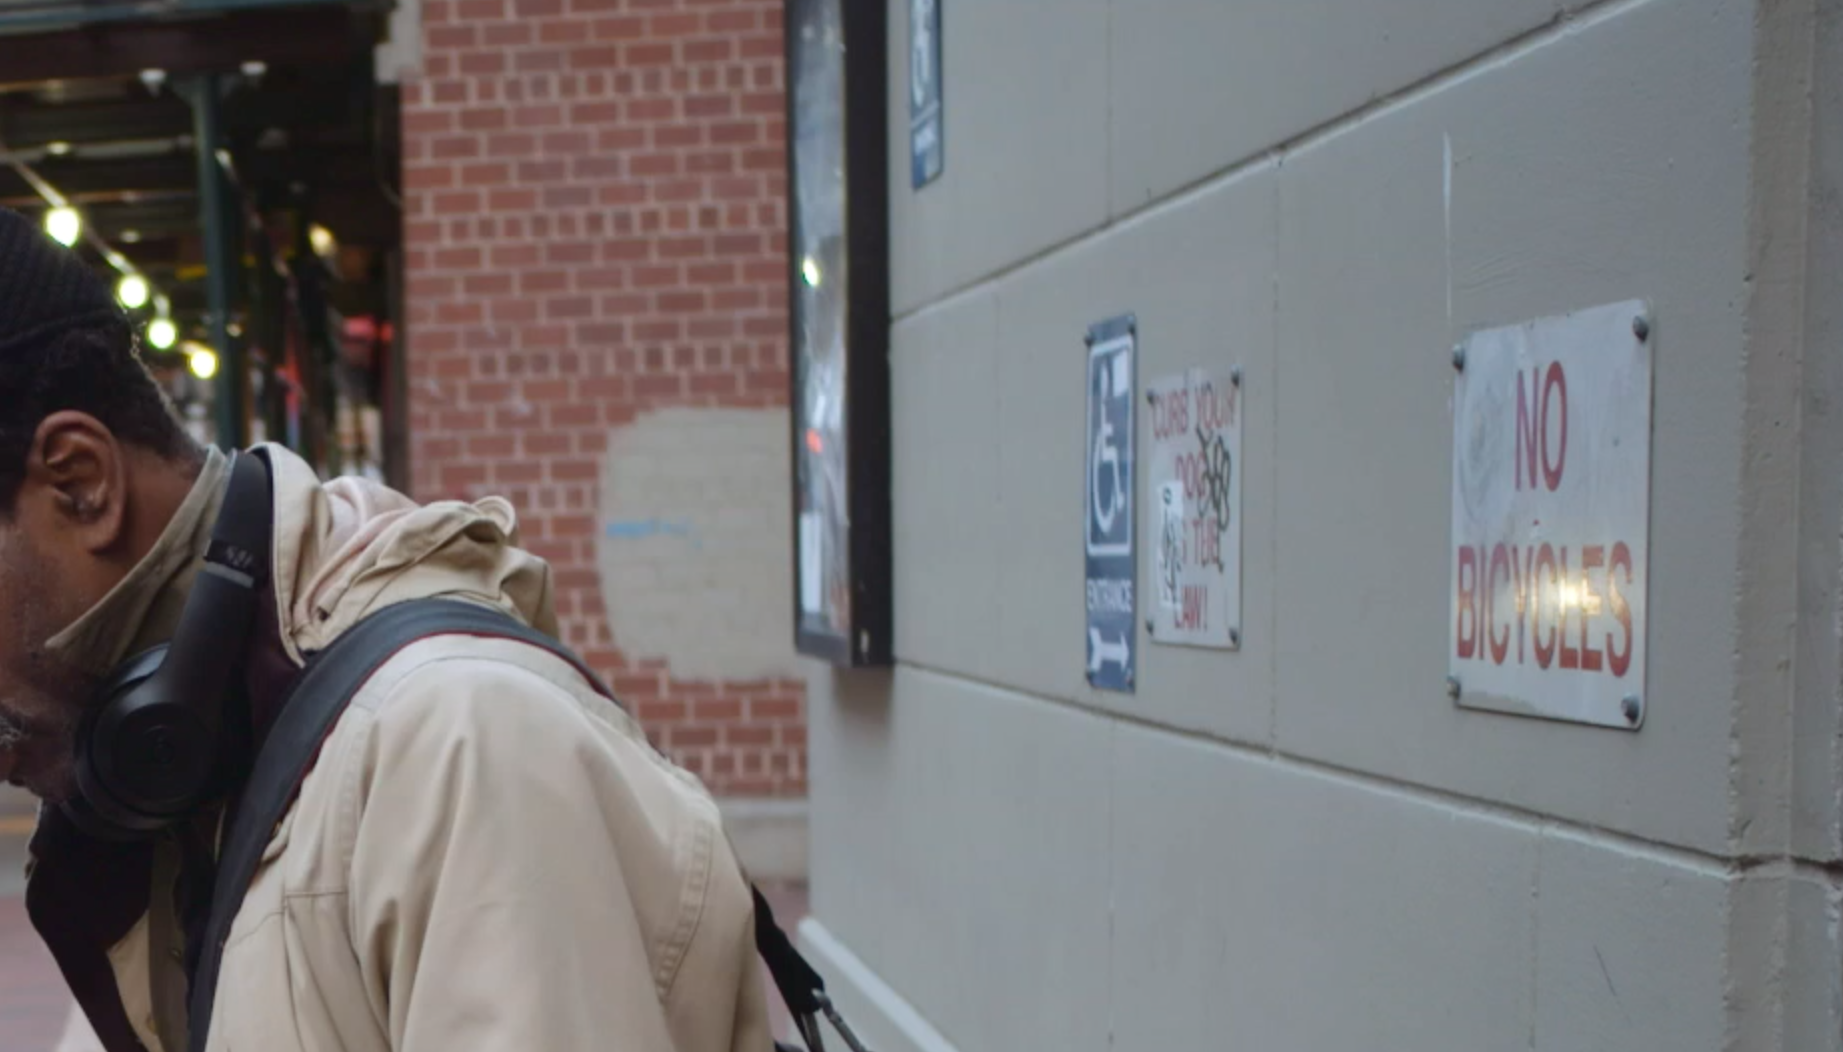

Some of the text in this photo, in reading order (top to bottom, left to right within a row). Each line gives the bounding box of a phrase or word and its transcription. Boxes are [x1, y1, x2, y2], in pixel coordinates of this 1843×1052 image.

[1152, 387, 1188, 440] CURB
[1515, 360, 1568, 492] NO
[1193, 517, 1220, 568] THE
[1457, 541, 1634, 678] BICYCLES
